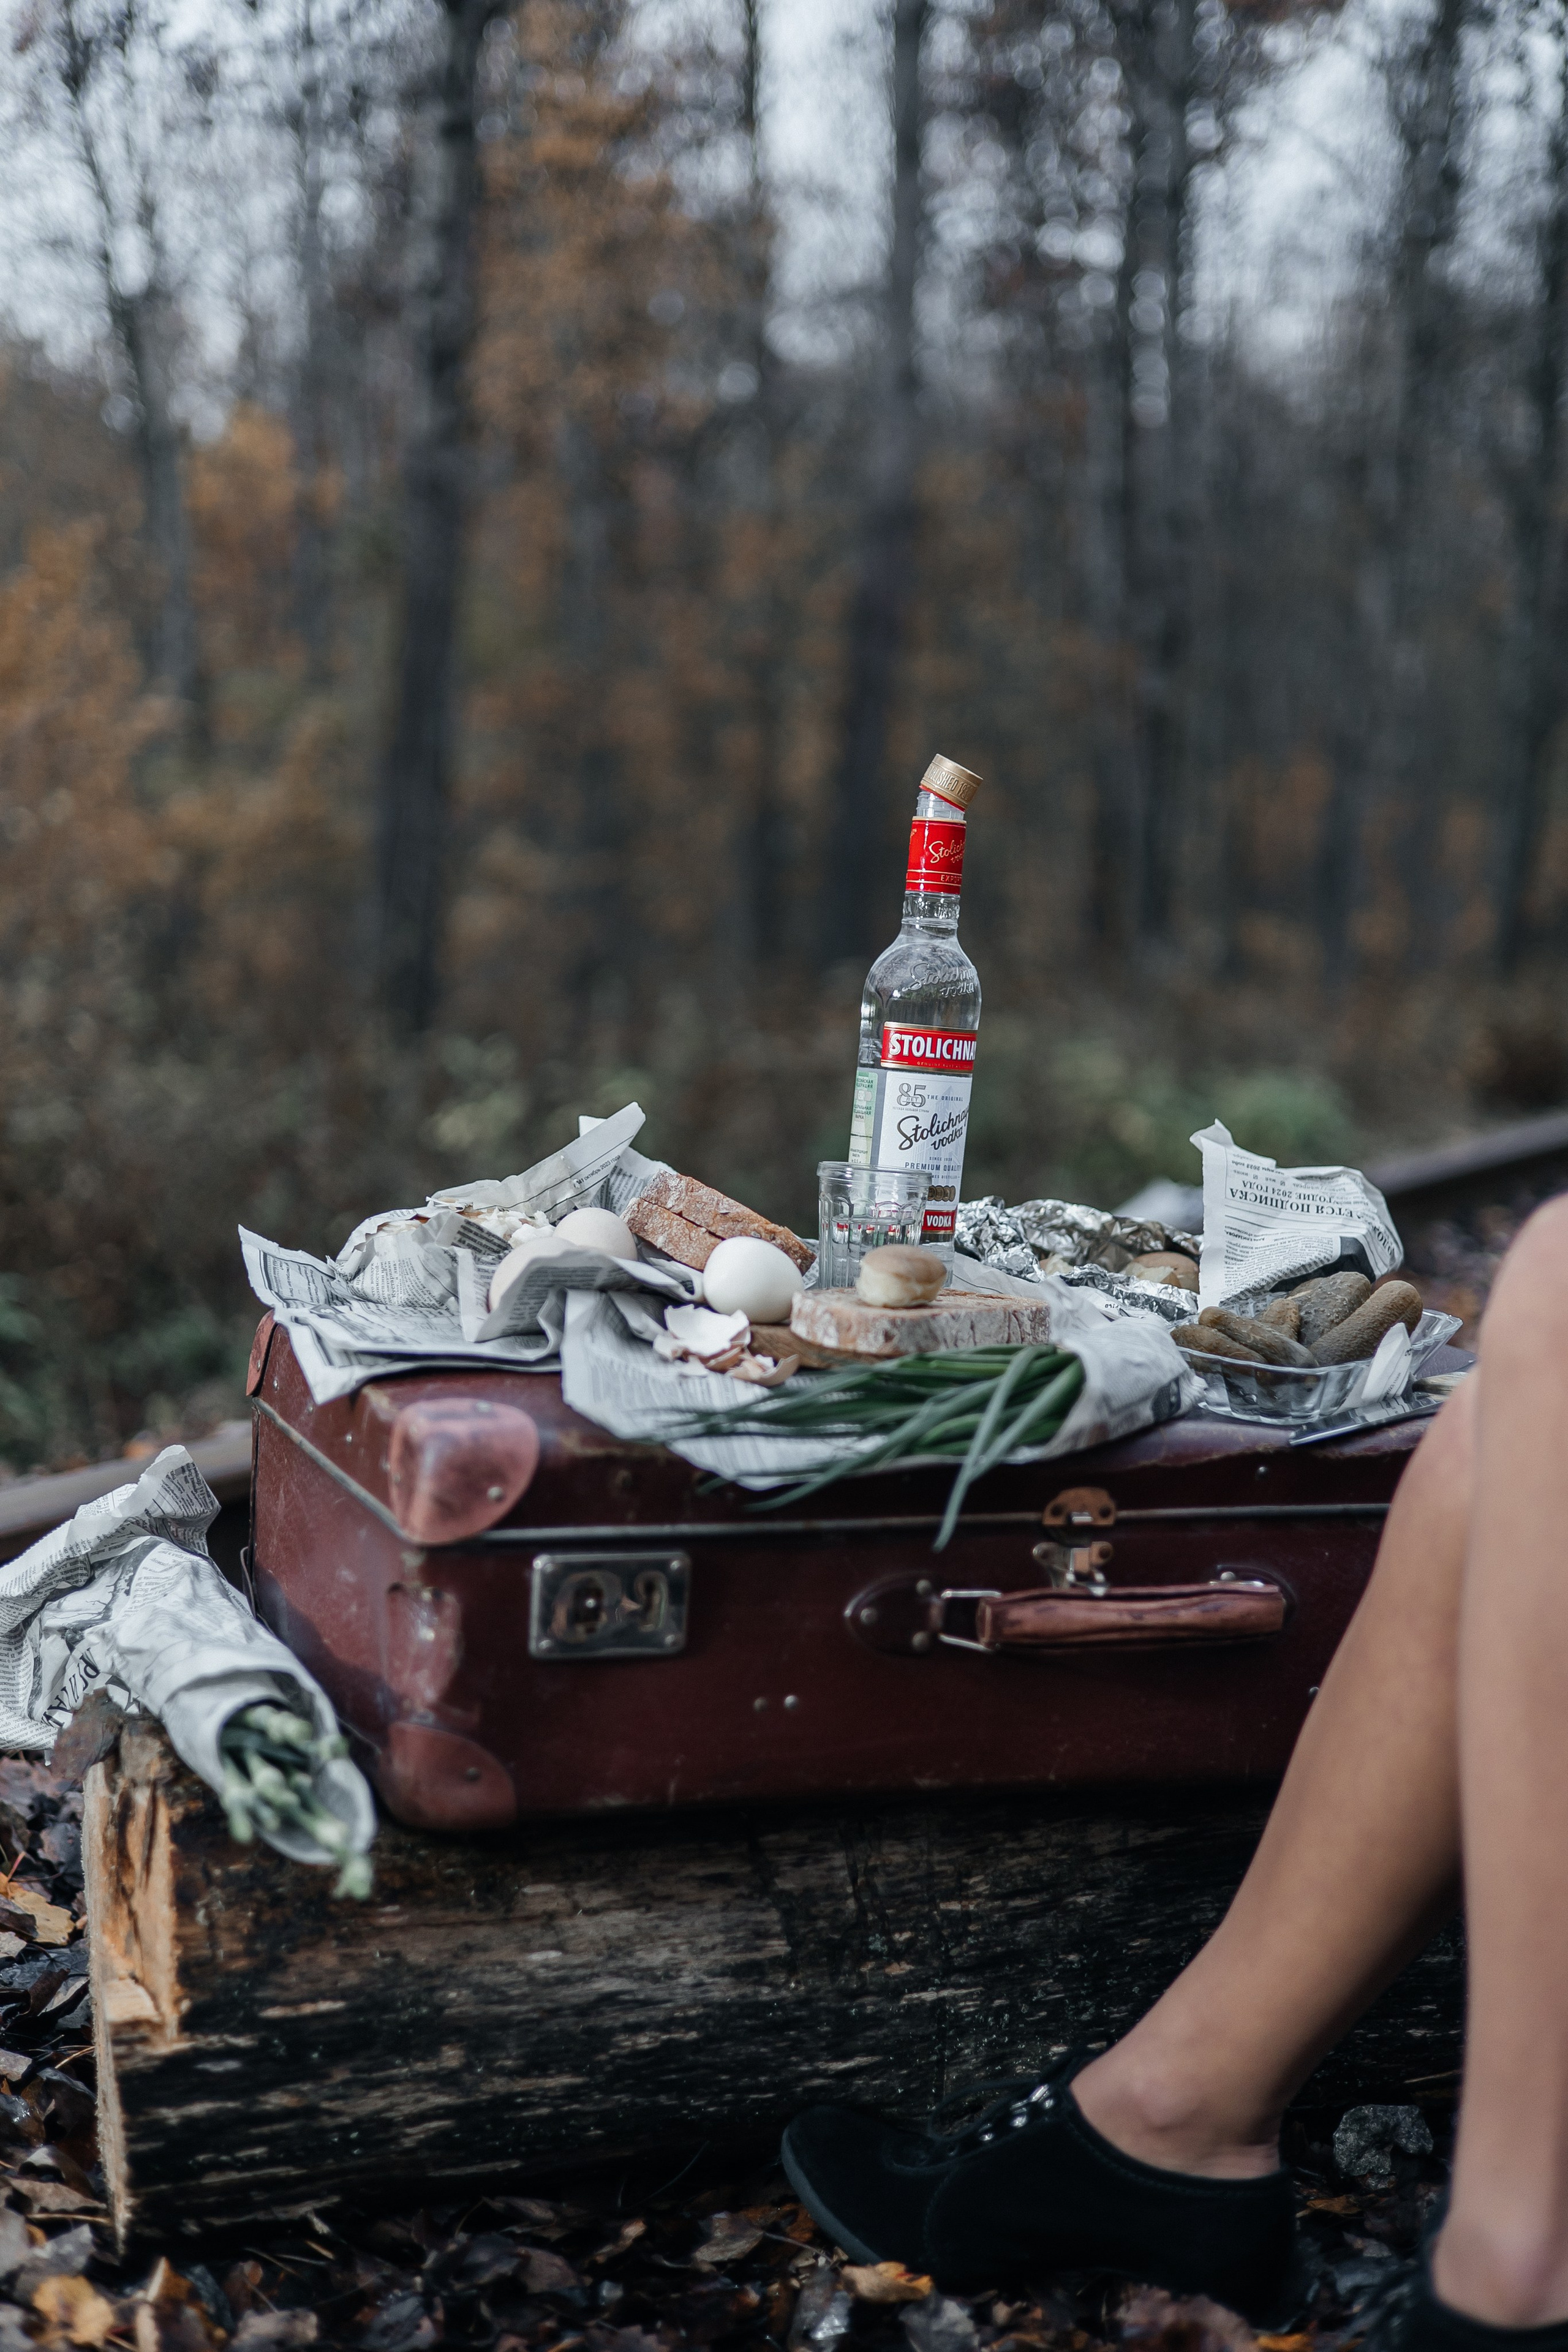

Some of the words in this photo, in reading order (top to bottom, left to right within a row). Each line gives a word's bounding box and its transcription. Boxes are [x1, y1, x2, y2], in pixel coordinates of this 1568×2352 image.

[897, 1083, 926, 1107] 85
[930, 1125, 963, 1150] vodka
[600, 1160, 611, 1170] 2023
[905, 1162, 941, 1172] PREMIUM
[1242, 1180, 1268, 1193] ГОДА
[1272, 1187, 1292, 1199] 2024
[1229, 1187, 1311, 1214] ПОДПИСКА
[926, 1215, 952, 1228] VODKA
[387, 1261, 396, 1298] Кустарники
